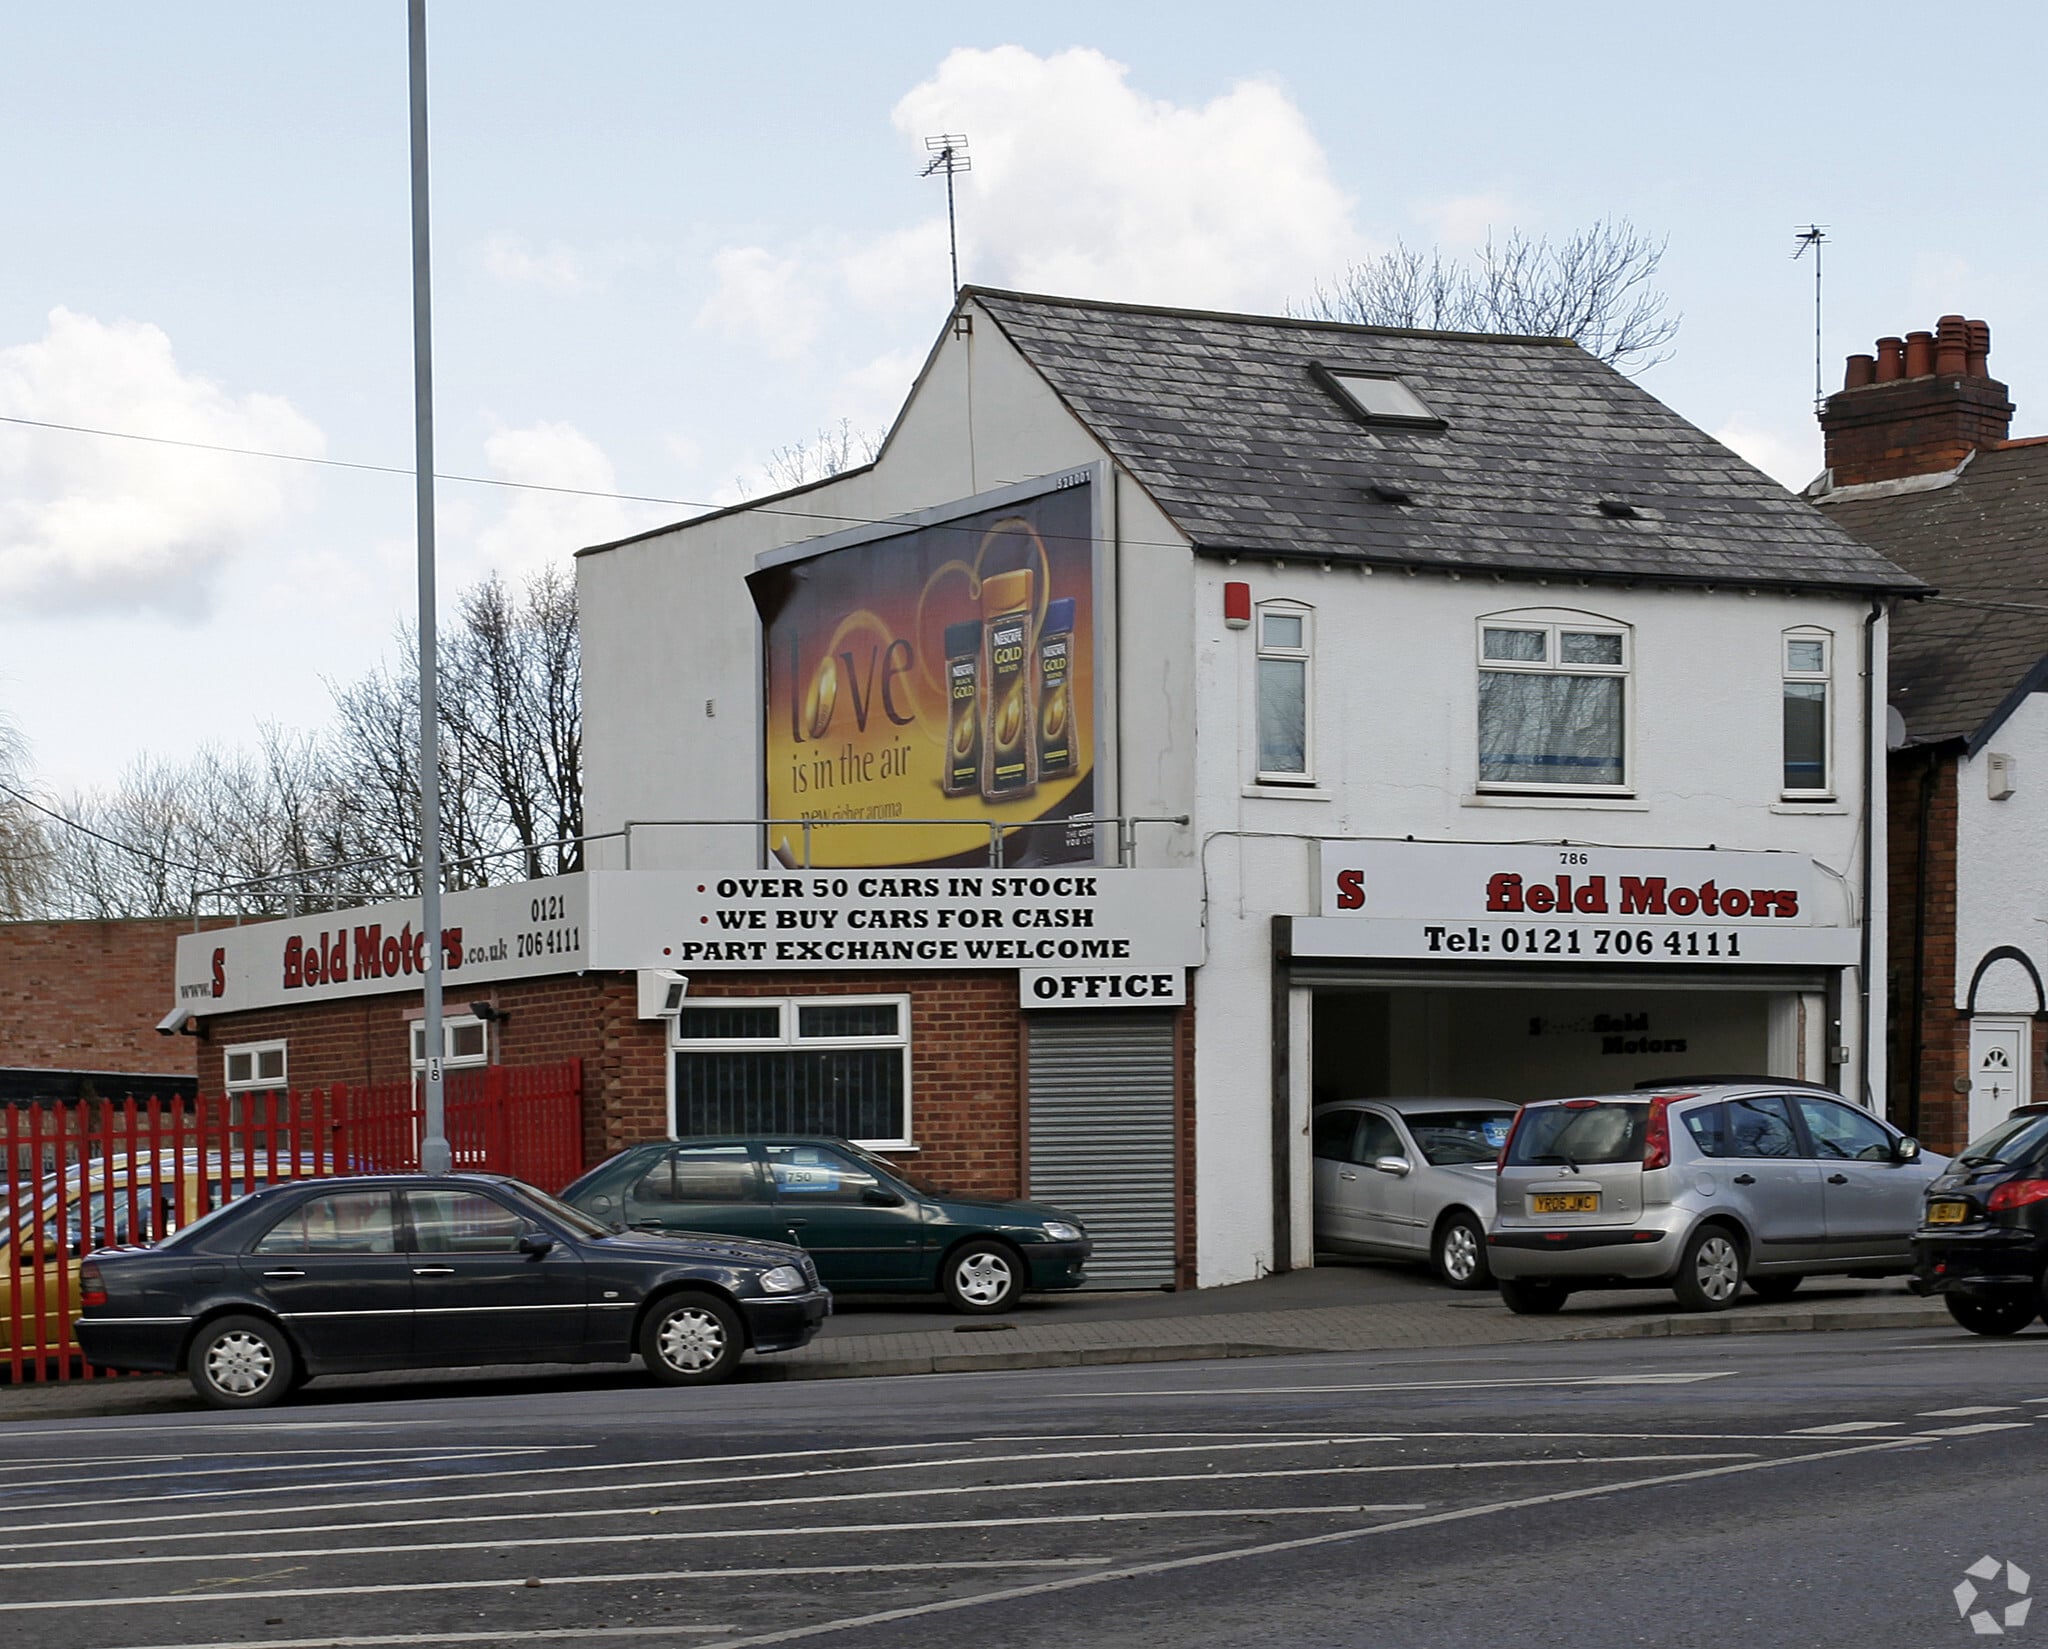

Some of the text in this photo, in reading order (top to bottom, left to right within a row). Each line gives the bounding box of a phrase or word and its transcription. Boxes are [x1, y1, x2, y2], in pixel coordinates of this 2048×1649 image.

[995, 646, 1023, 665] GOLD
[1043, 658, 1066, 672] GOLD
[953, 685, 975, 699] GOLD
[792, 735, 911, 793] is in the air
[1560, 853, 1588, 865] 786
[716, 877, 1098, 898] OVER 50 CARS IN STOCK
[1336, 869, 1800, 918] S field Motors
[531, 894, 565, 923] 0121
[716, 908, 1094, 930] WE BUY CARS FOR CASH
[517, 926, 581, 959] 706 4111
[682, 939, 1131, 961] PART EXCHANGE WELCOME
[1424, 926, 1741, 957] Tel: 0121 706 4111
[283, 928, 348, 990] field
[1033, 974, 1174, 999] OFFICE
[1602, 1036, 1687, 1055] Motors
